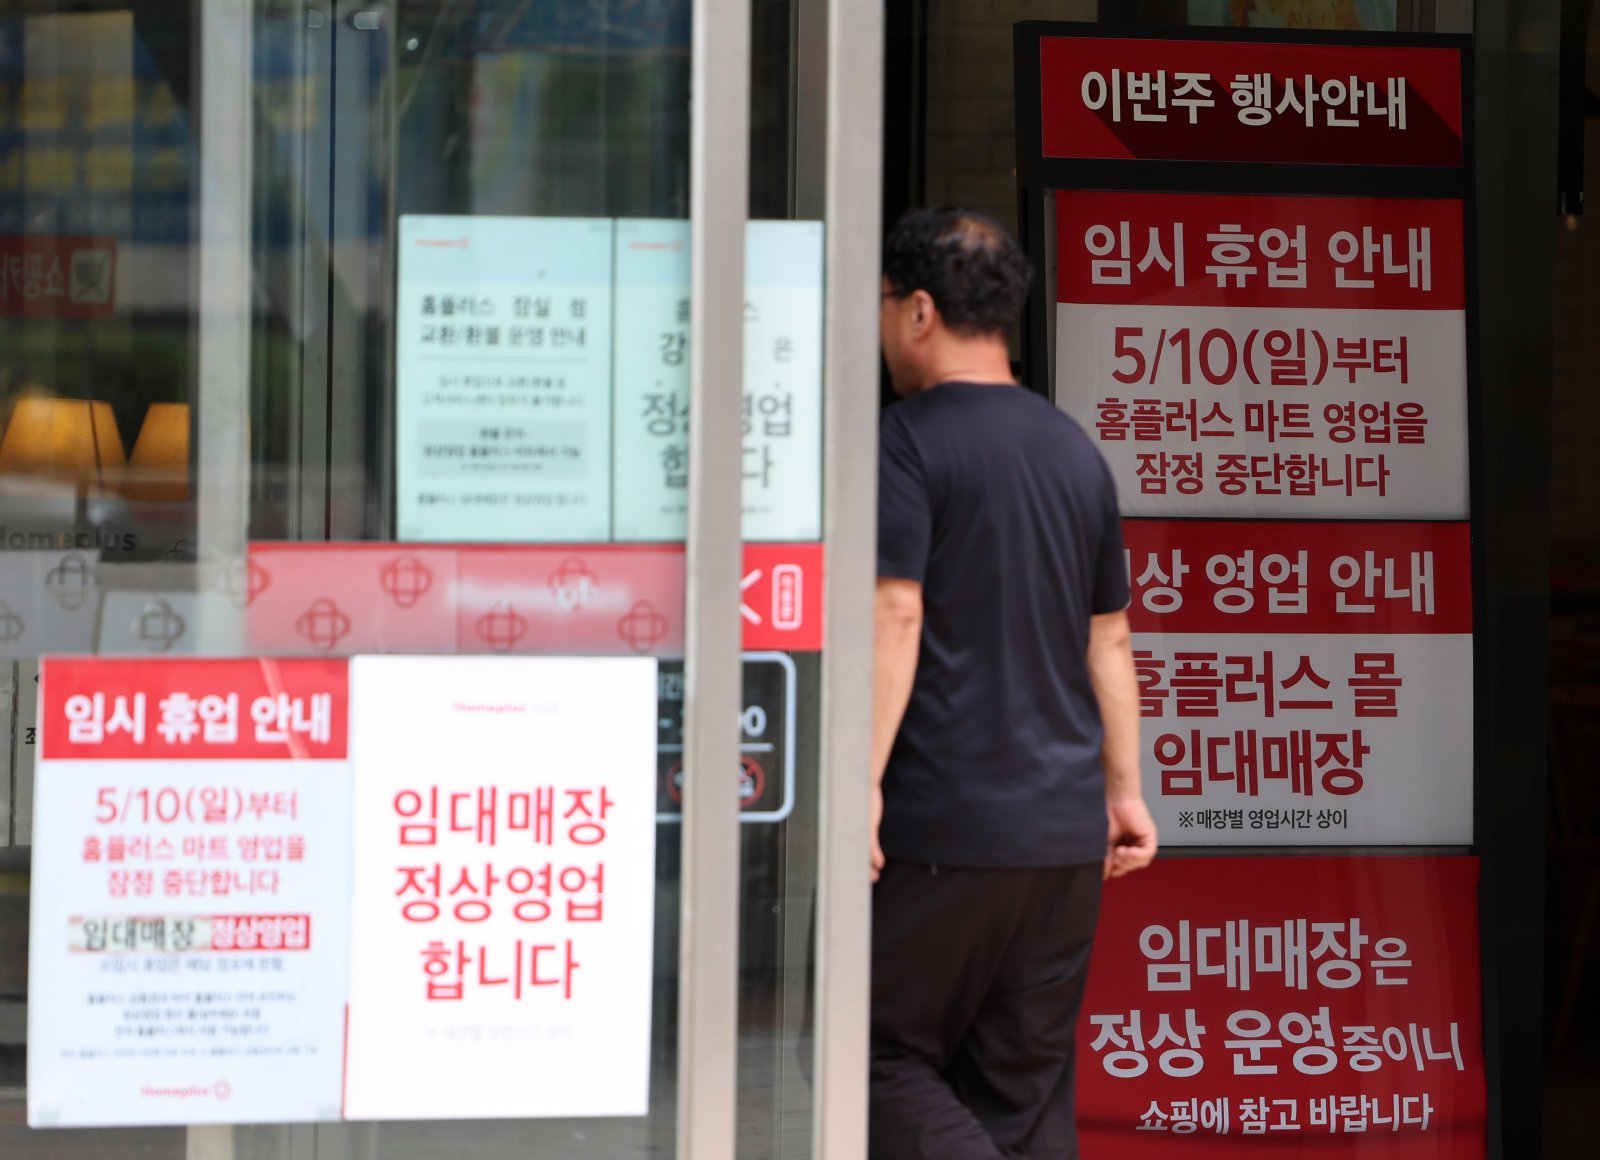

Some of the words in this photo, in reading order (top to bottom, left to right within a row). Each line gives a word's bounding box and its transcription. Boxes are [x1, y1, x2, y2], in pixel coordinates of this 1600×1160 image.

[1082, 69, 1214, 124] 이번주
[1230, 73, 1406, 129] 행사안내
[1085, 221, 1184, 286] 임시
[1206, 224, 1307, 288] 휴업
[1328, 227, 1431, 291] 안내
[1113, 327, 1408, 385] 5/10(일)부터
[642, 391, 792, 437] 정업
[1096, 398, 1234, 441] 홈플러스
[1245, 400, 1313, 442] 마트
[1324, 401, 1427, 444] 영업을
[660, 443, 774, 489] 합다
[1136, 452, 1203, 494] 잠정
[1216, 453, 1390, 496] 중단합니다
[1206, 550, 1307, 613] 영업
[1330, 551, 1434, 614] 안내
[1133, 651, 1333, 717] 홈플러스
[1348, 653, 1402, 717] 몰
[64, 692, 146, 744] 임시
[156, 692, 239, 744] 휴업
[250, 692, 332, 745] 안내
[1154, 730, 1370, 796] 임대매장
[96, 786, 297, 825] 5/10(일)부터
[393, 785, 614, 846] 임대매장
[1249, 809, 1312, 829] 영업시간
[1317, 809, 1347, 828] 상이
[81, 836, 176, 863] 홈플러스
[182, 836, 229, 861] 마트
[237, 835, 305, 862] 영업을
[108, 869, 154, 897] 잠정
[162, 869, 280, 897] 중단합니다
[395, 862, 604, 923] 정상영업
[83, 917, 196, 952] 임대매장
[211, 916, 307, 949] 정상영업
[1139, 918, 1411, 991] 임대매장은
[420, 939, 580, 1001] 합니다
[1090, 1009, 1206, 1078] 정상
[1224, 1007, 1464, 1075] 운영중이니
[1137, 1097, 1229, 1134] 쇼핑에
[1239, 1097, 1300, 1134] 참고
[1310, 1094, 1433, 1133] 바랍니다
